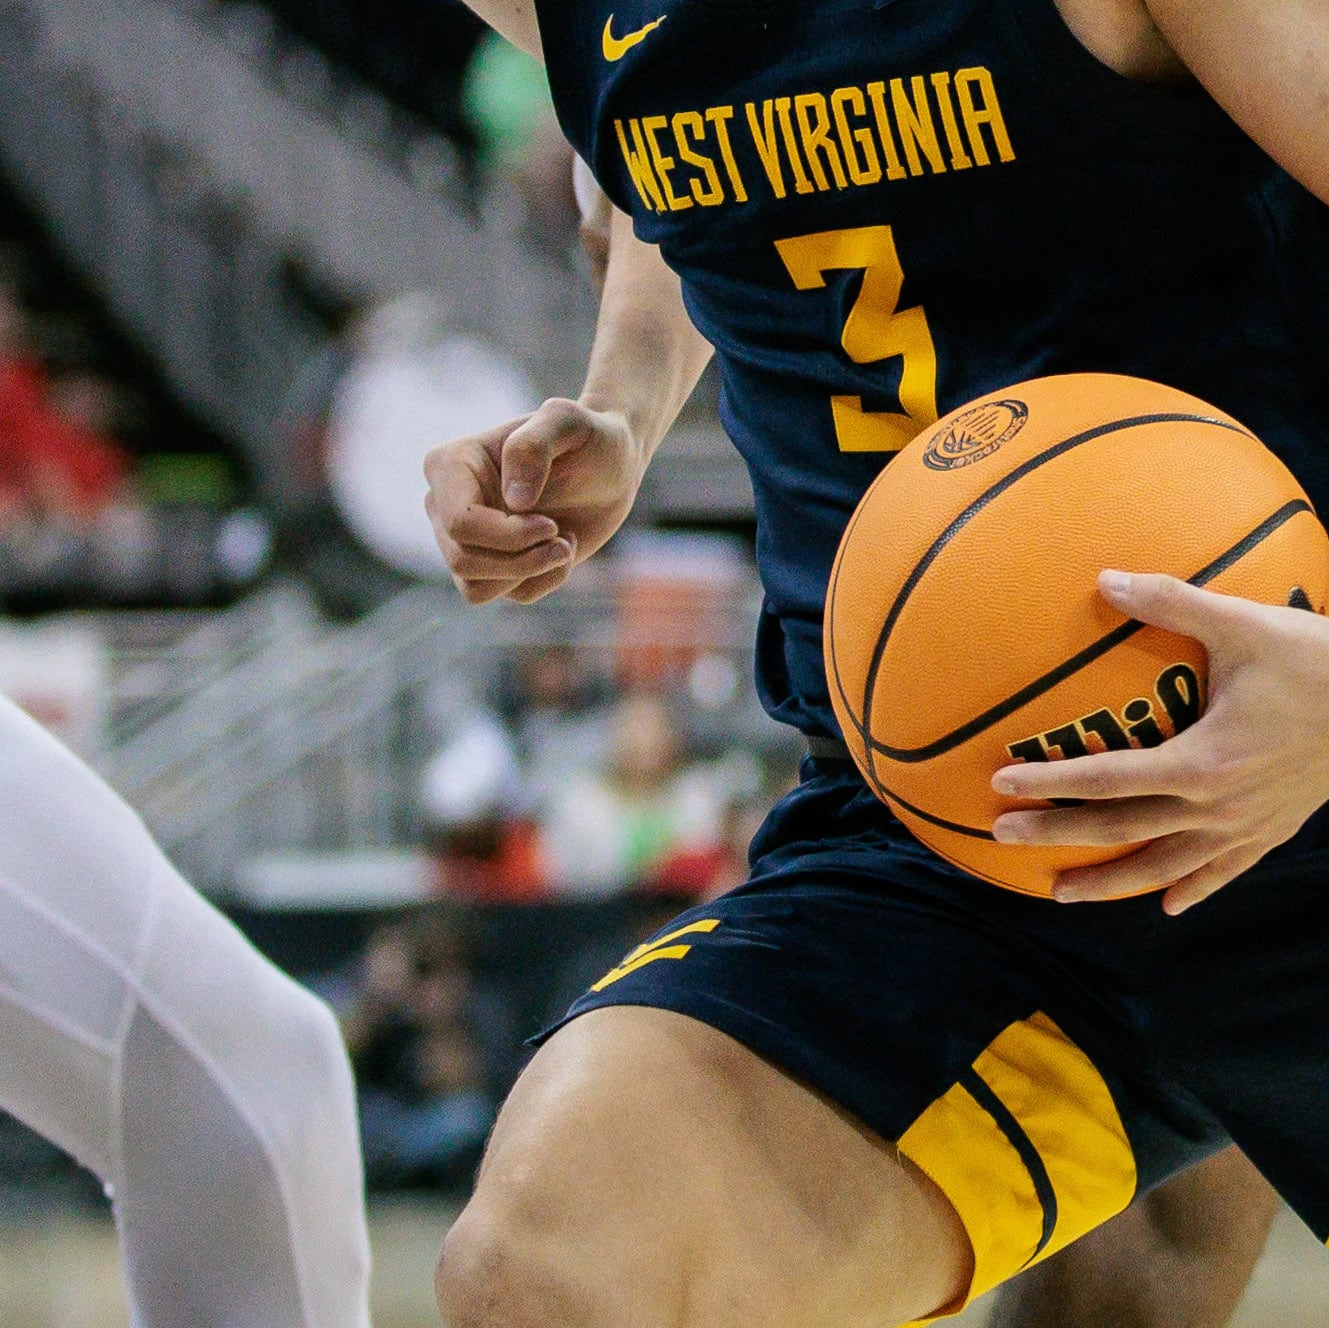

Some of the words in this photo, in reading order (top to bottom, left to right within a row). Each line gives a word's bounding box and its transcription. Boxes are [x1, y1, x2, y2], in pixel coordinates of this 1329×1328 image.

[614, 105, 748, 213] WEST
[747, 66, 1016, 200] VIRGINIA
[773, 225, 939, 454] 3
